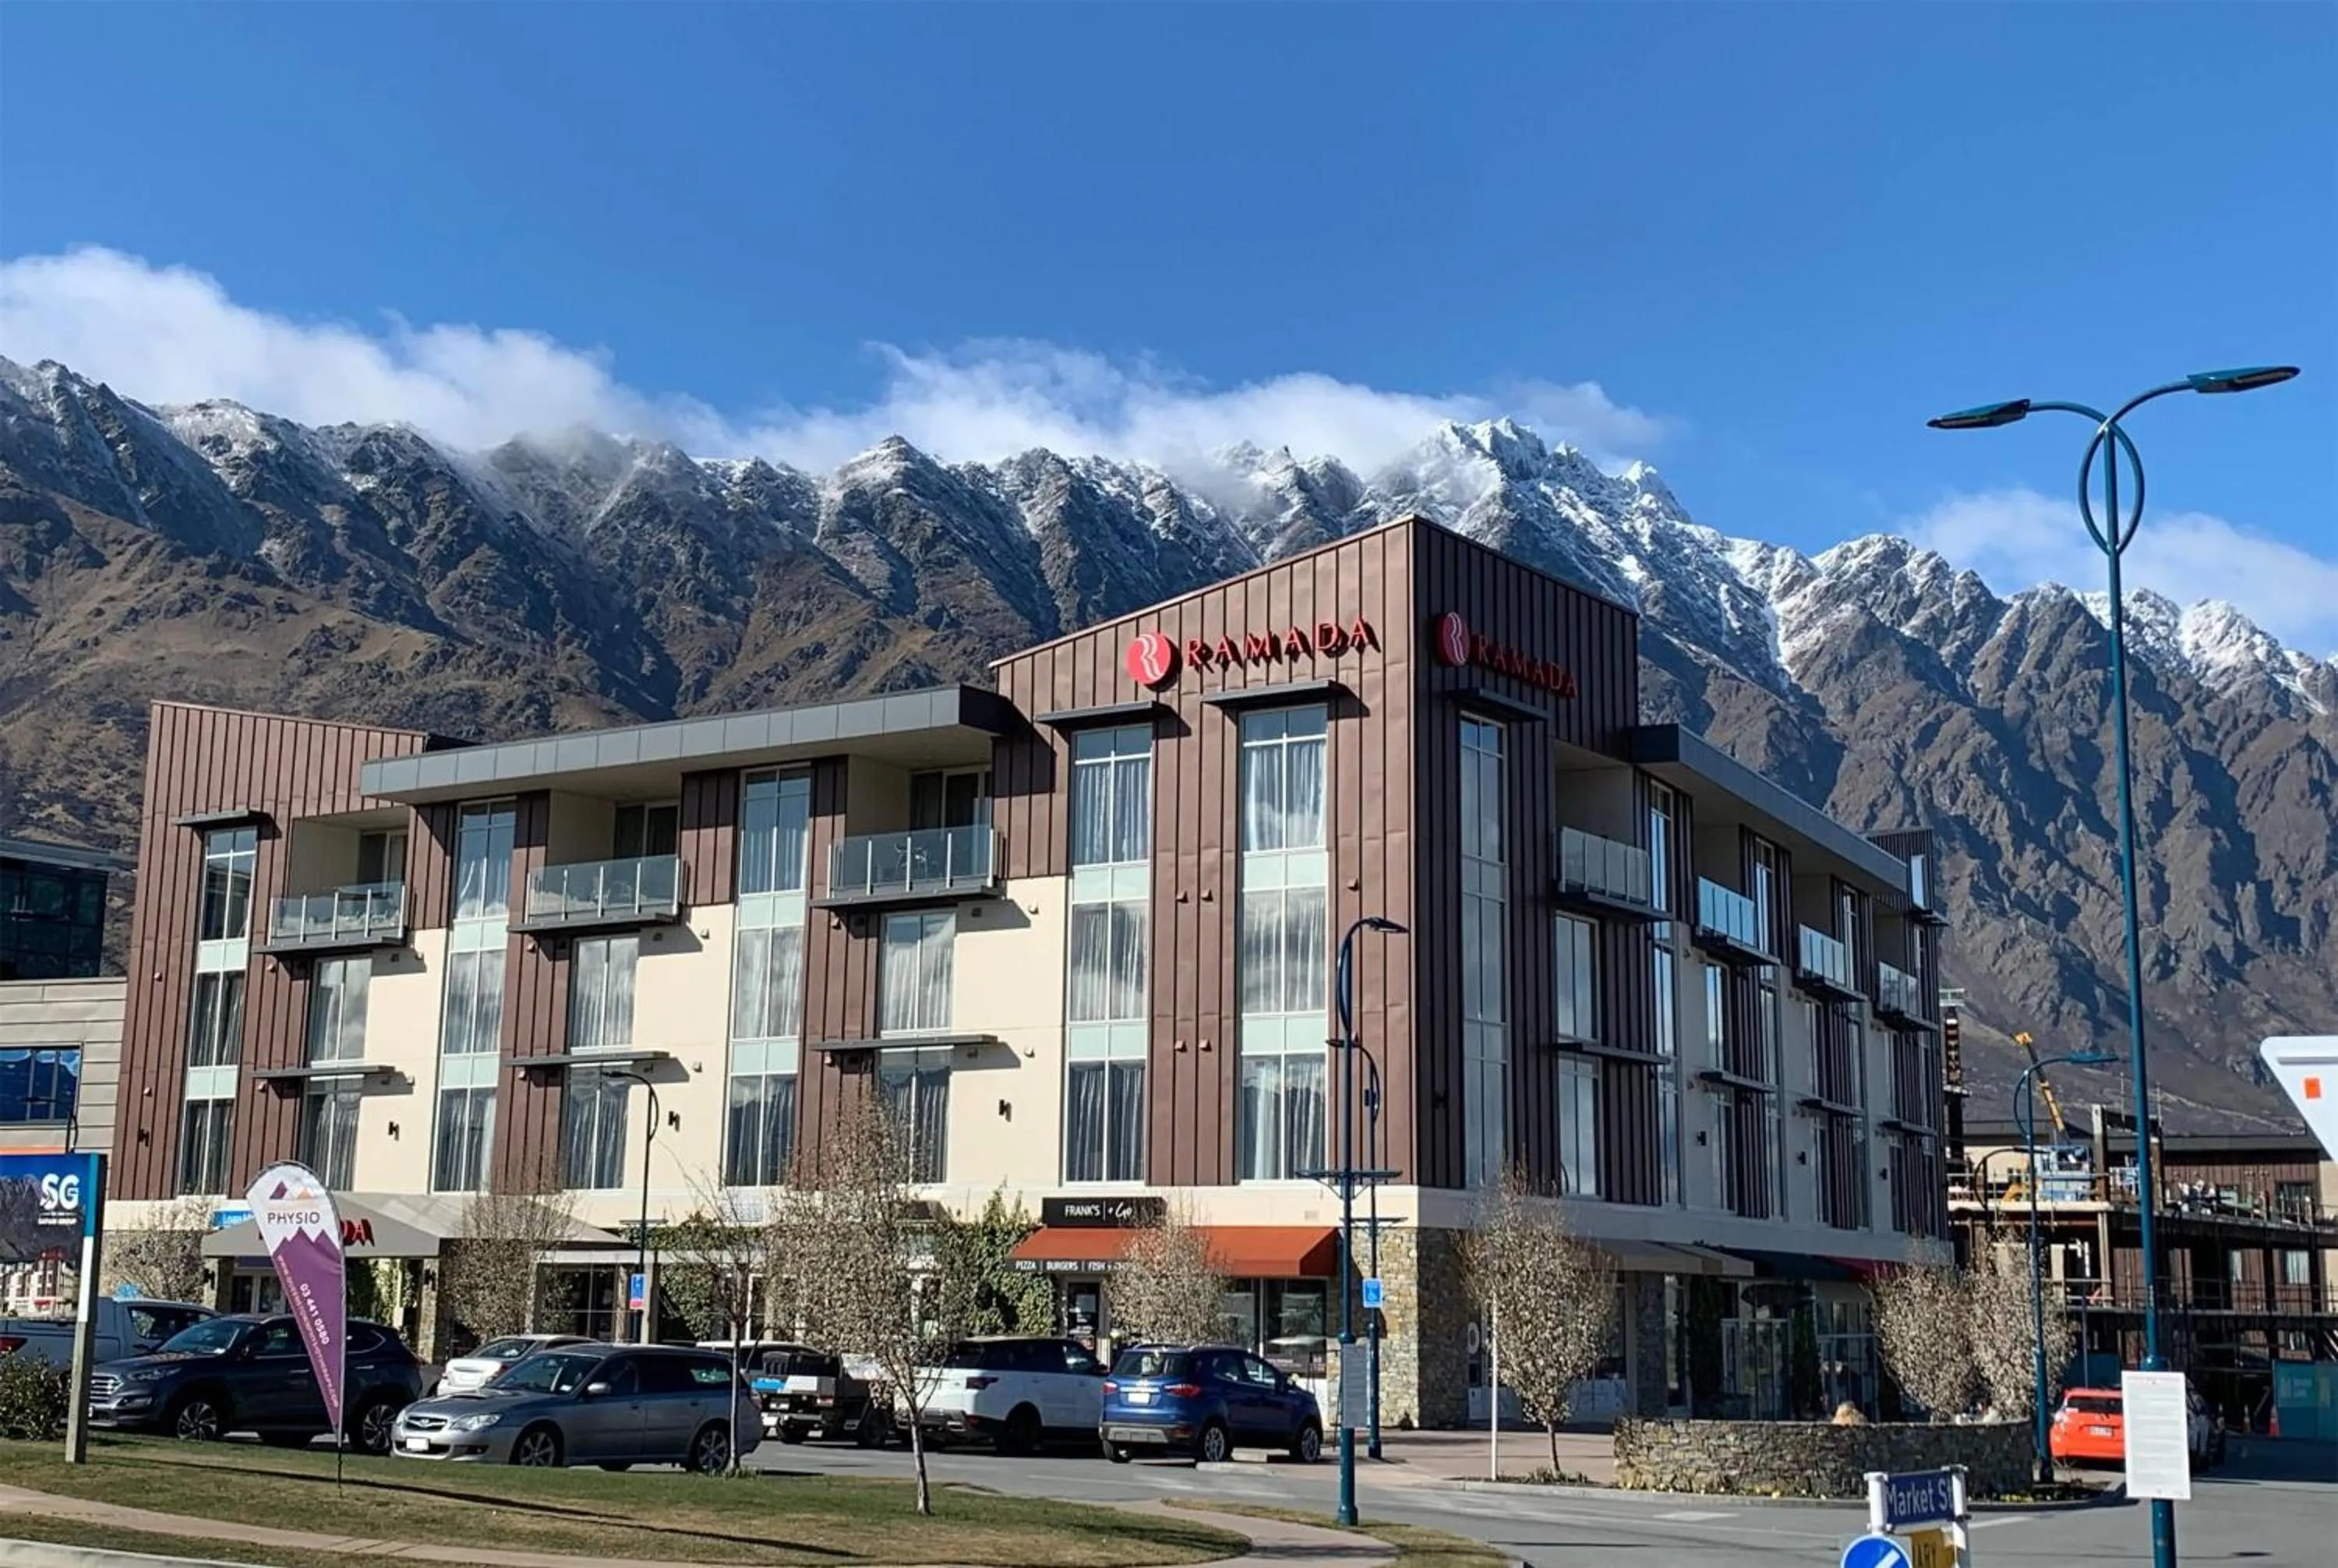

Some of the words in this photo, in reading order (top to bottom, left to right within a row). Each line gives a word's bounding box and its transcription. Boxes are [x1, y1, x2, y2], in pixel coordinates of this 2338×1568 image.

[1185, 615, 1370, 669] RAMADA
[1476, 634, 1579, 697] RAMADA
[40, 1172, 80, 1211] SG
[267, 1211, 321, 1225] PHYSIO
[1015, 1260, 1037, 1271] PIZZA
[1046, 1261, 1079, 1272] BURGERS
[299, 1283, 312, 1298] 03
[306, 1298, 320, 1318] 441
[1887, 1479, 1936, 1517] Market
